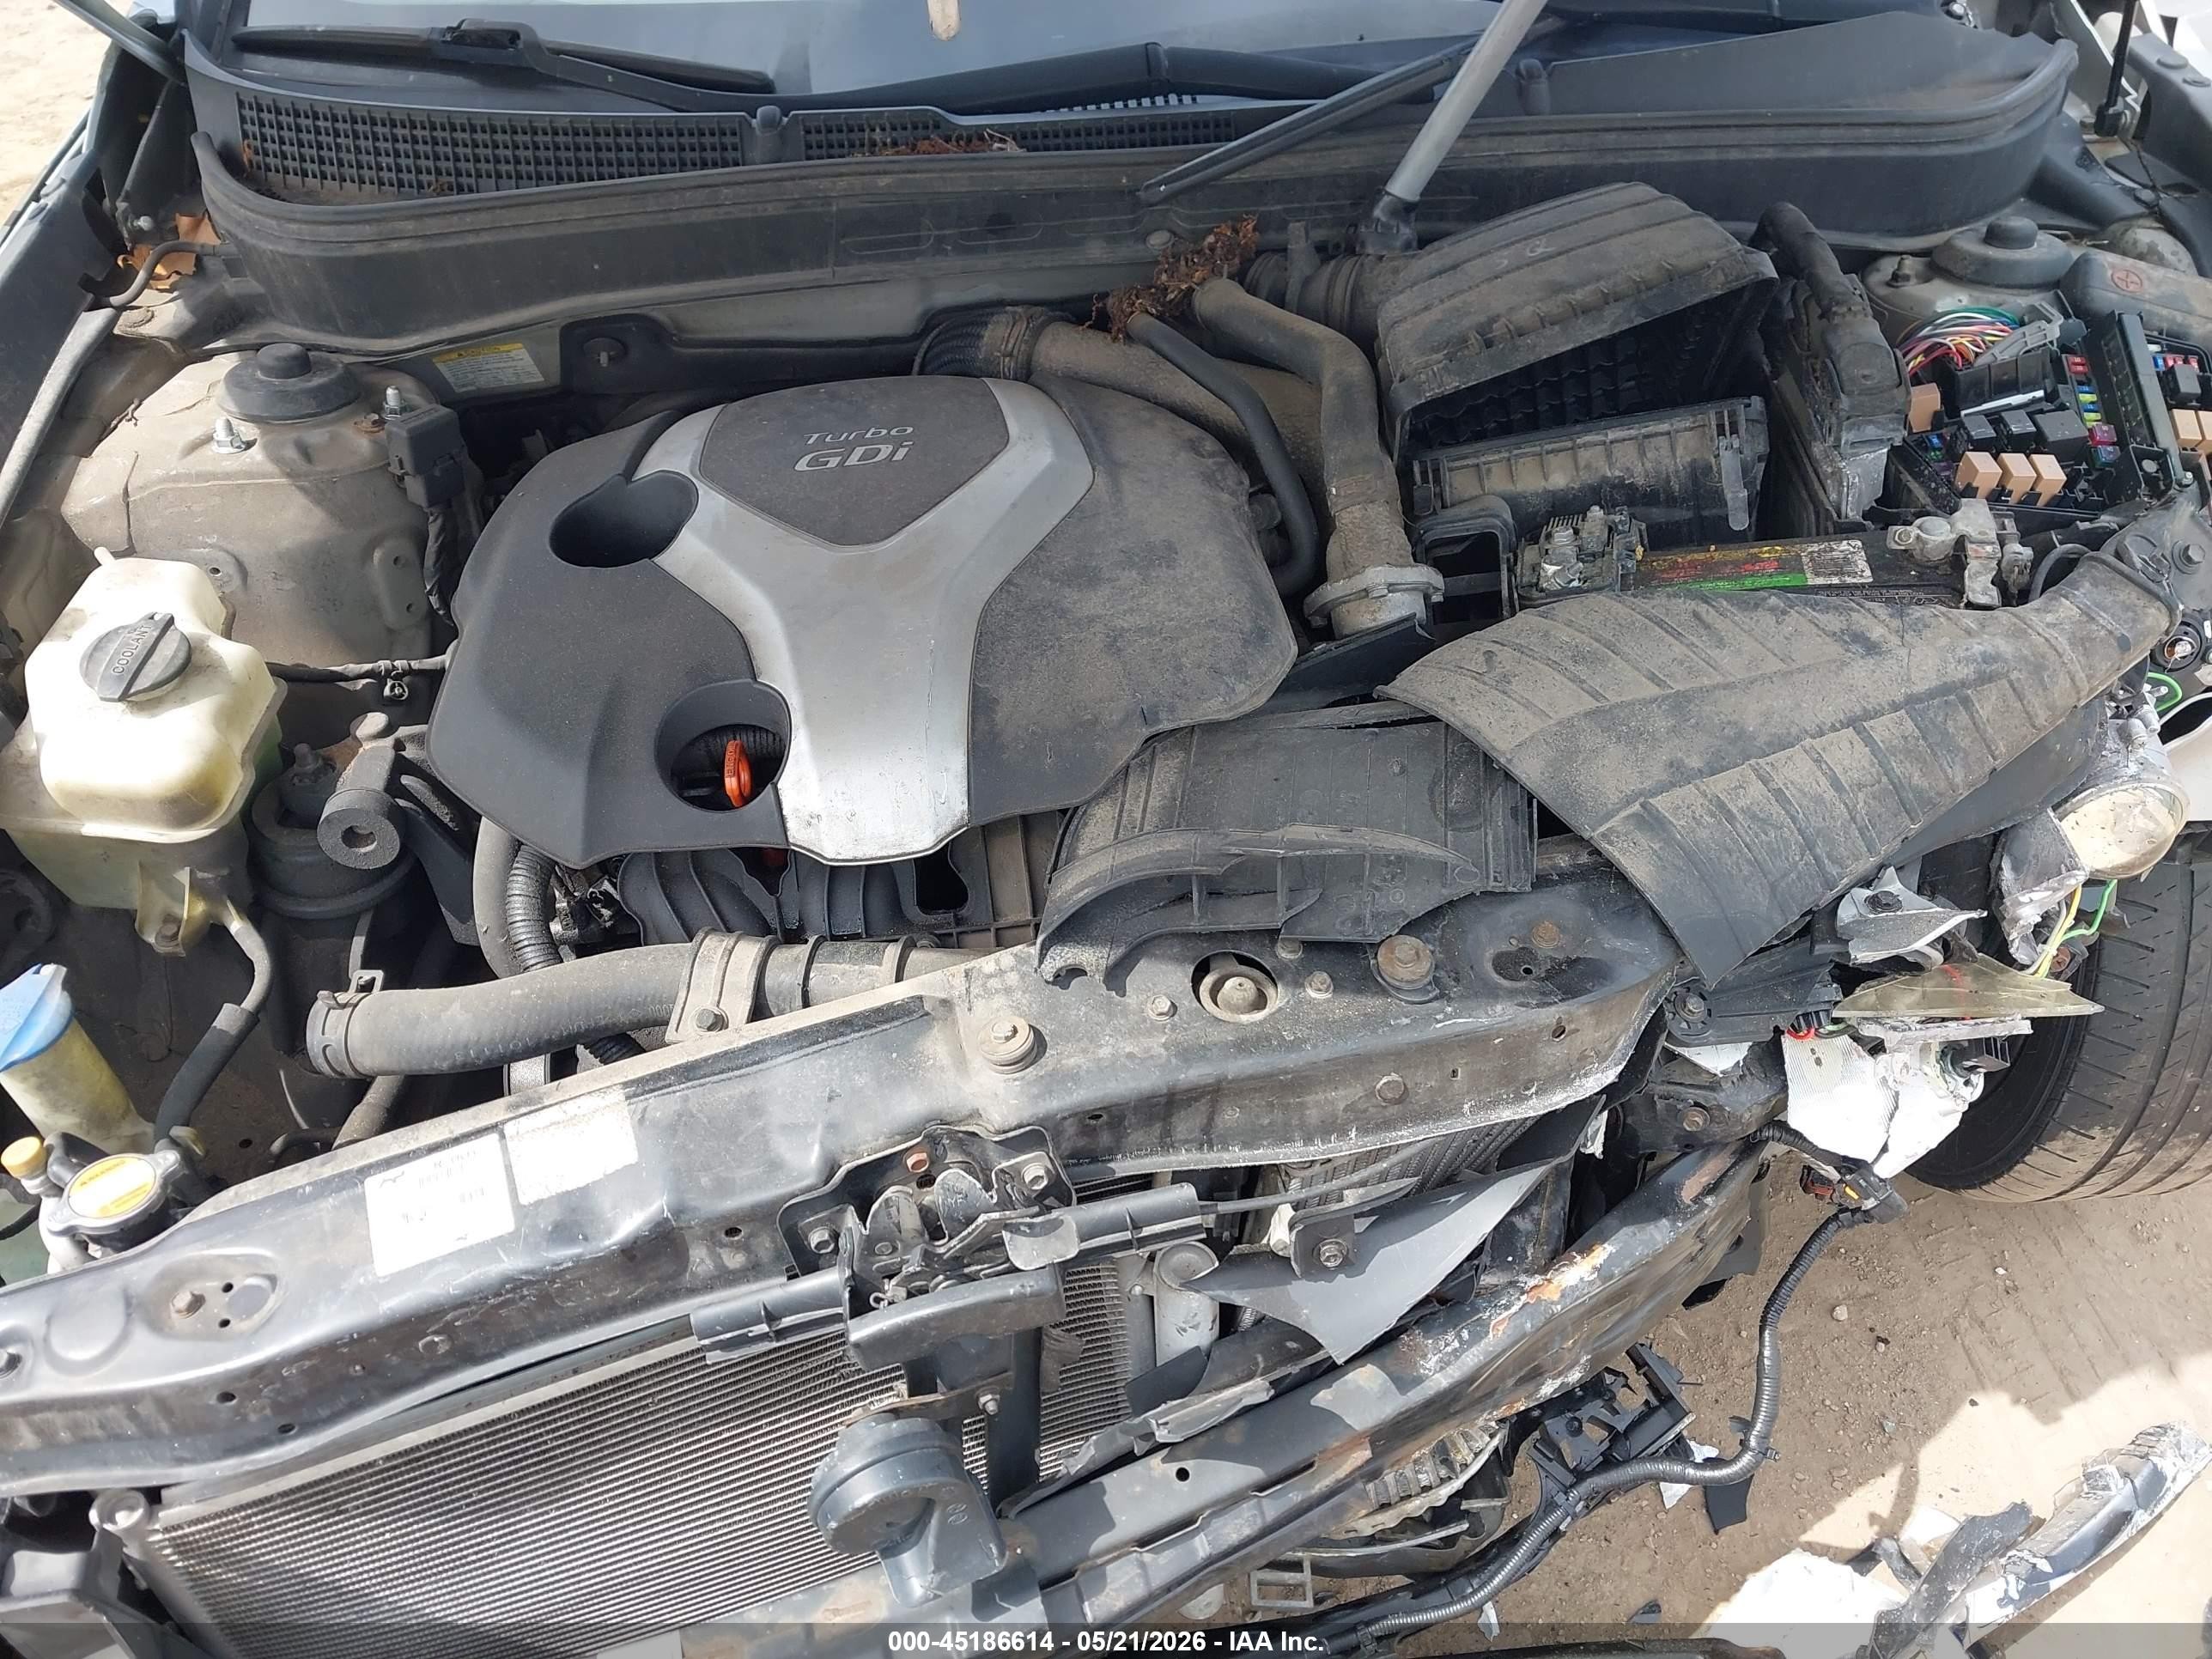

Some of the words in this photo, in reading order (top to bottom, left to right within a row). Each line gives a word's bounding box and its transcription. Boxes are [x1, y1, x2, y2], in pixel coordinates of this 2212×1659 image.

[803, 426, 914, 445] Turbo
[793, 441, 914, 471] GDi
[112, 625, 152, 674] COOLANT
